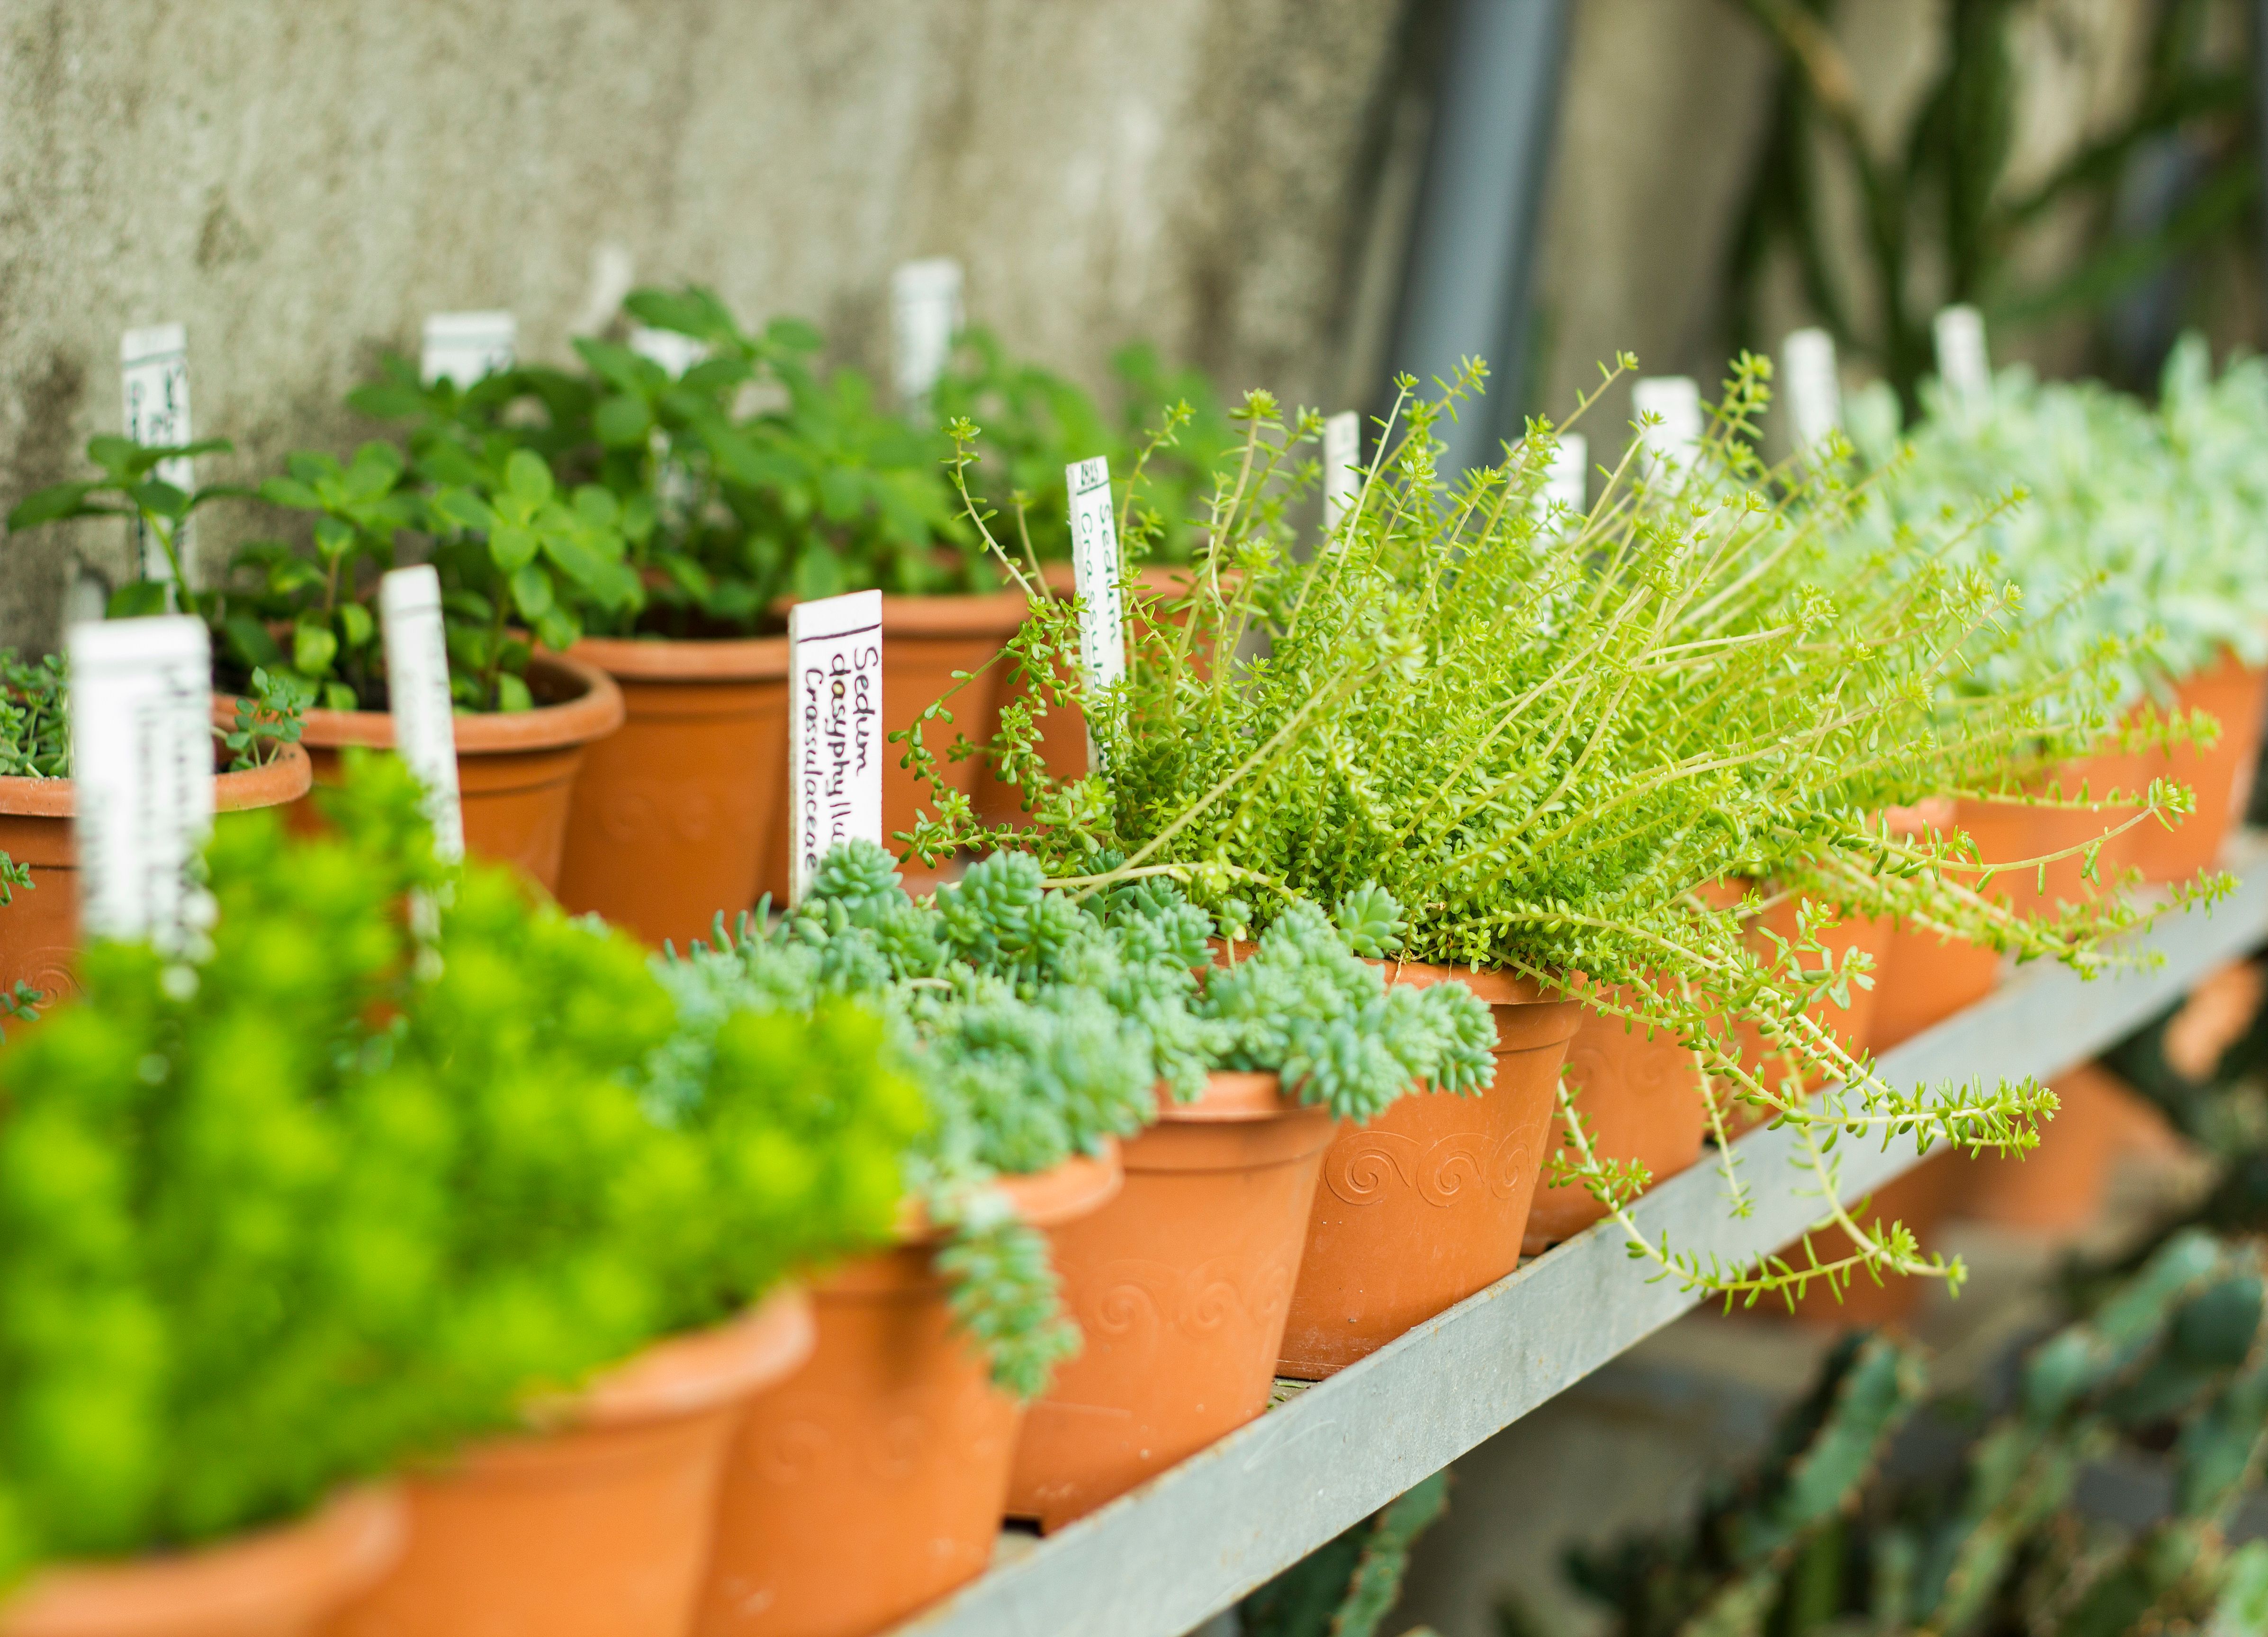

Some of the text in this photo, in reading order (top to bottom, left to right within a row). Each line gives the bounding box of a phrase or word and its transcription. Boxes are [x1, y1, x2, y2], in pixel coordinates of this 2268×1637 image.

[1099, 504, 1117, 645] Sedum
[804, 668, 824, 871] Crassulaceae
[825, 653, 852, 842] dasyphyllu
[853, 646, 879, 777] Sedum
